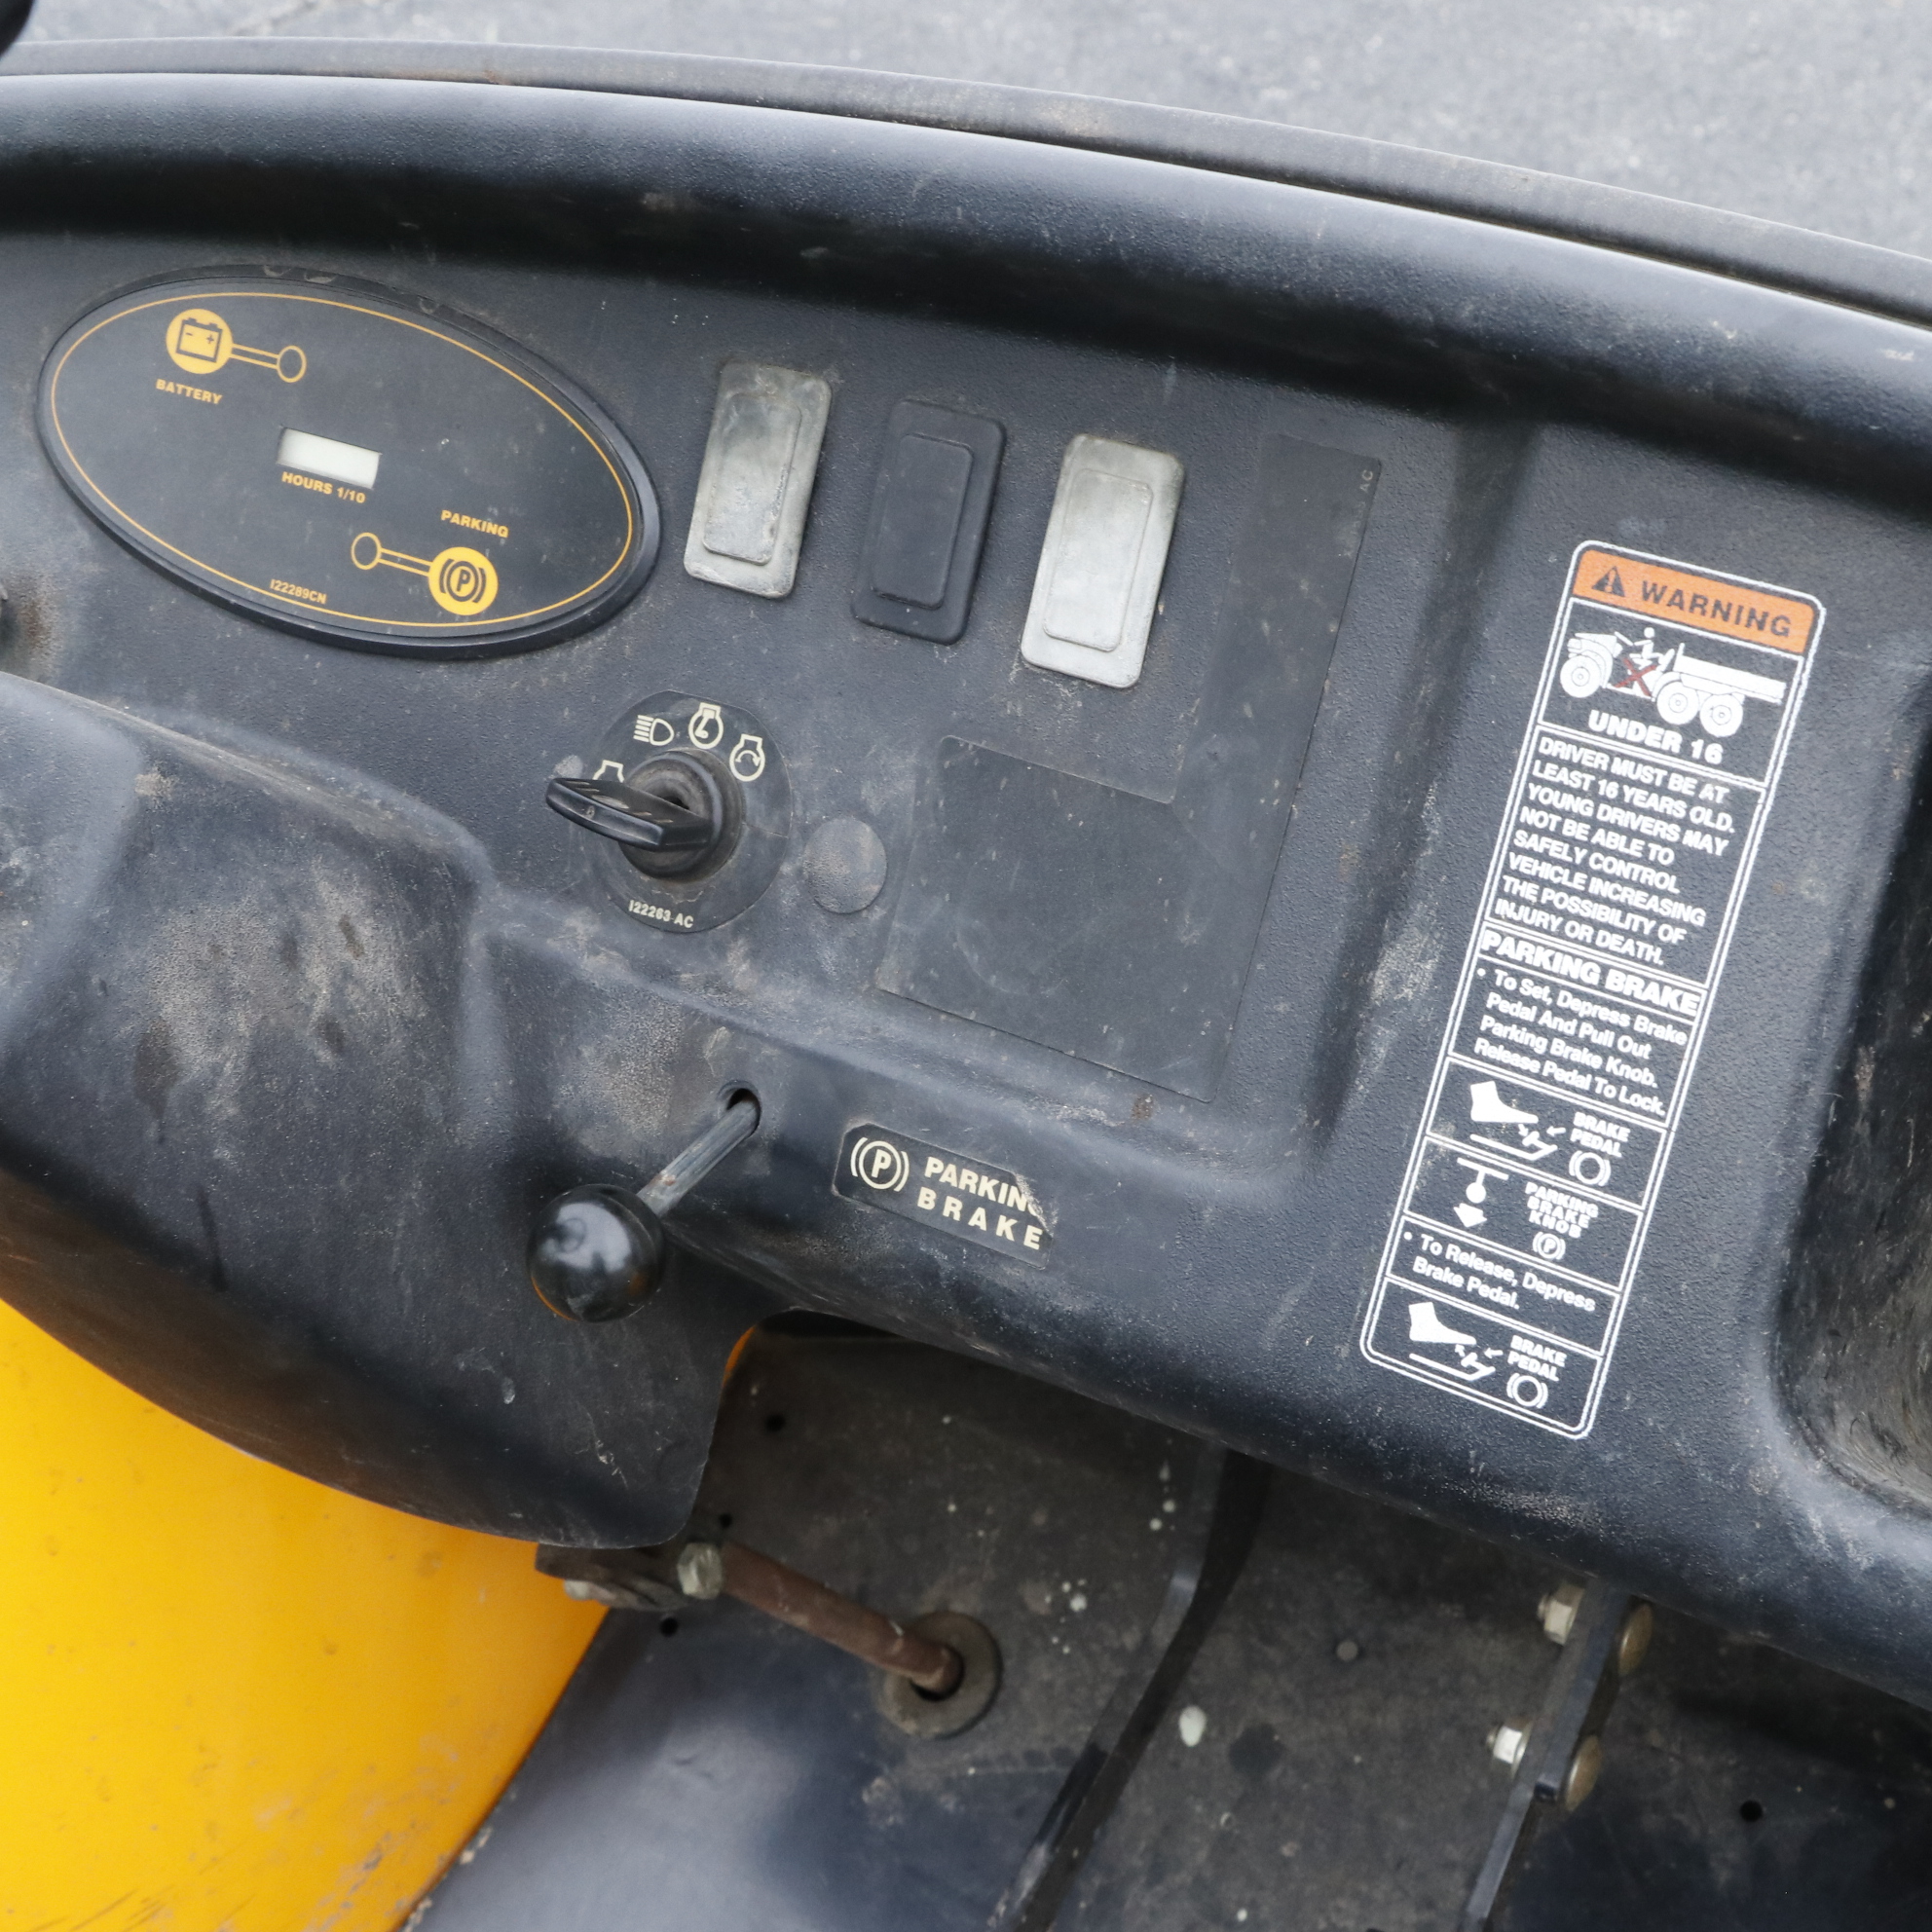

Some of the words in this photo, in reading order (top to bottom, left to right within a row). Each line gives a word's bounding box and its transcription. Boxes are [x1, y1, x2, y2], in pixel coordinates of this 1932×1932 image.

[155, 379, 222, 405] BATTERY
[281, 471, 333, 495] HOURS
[337, 487, 366, 503] 1/10
[440, 509, 509, 539] PARKING
[1642, 580, 1791, 637] WARNING
[1588, 710, 1683, 753] UNDER
[1691, 739, 1724, 764] 16
[1532, 760, 1595, 791] LEAST
[1598, 779, 1619, 799] 16
[1622, 785, 1688, 819] YEARS
[1690, 806, 1735, 833] OLD.
[1539, 737, 1610, 770] DRIVER
[1611, 758, 1667, 786] MUST
[1667, 773, 1697, 797] BE
[1698, 784, 1730, 803] AT
[1520, 806, 1562, 831] NOT
[1562, 819, 1591, 840] BE
[1590, 832, 1645, 858] ABLE
[1648, 842, 1675, 865] TO
[1529, 783, 1594, 817] YOUNG
[1597, 803, 1681, 842] DRIVERS
[1682, 830, 1729, 856] MAY
[1509, 852, 1588, 891] VEHICLE
[1588, 876, 1706, 926] INCREASING
[1513, 830, 1587, 865] SAFELY
[1589, 853, 1680, 894] CONTROL
[1495, 899, 1563, 932] INJURY
[1565, 920, 1594, 944] OR
[1595, 930, 1664, 965] DEATH.
[1503, 875, 1540, 901] THE
[1541, 888, 1656, 936] POSSIBILITY
[1657, 924, 1687, 944] OF
[1481, 929, 1601, 984] PARKING
[1605, 969, 1701, 1017] BRAKE
[1486, 992, 1537, 1022] Pedal
[1538, 1010, 1578, 1035] And
[1579, 1022, 1615, 1047] Pull
[1617, 1035, 1653, 1059] Out
[1495, 969, 1517, 990] To
[1519, 979, 1553, 1005] Set,
[1557, 990, 1631, 1027] Depress
[1634, 1015, 1688, 1045] Brake
[1474, 1037, 1541, 1073] Release
[1542, 1060, 1592, 1091] Pedal
[1594, 1077, 1616, 1098] To
[1618, 1086, 1666, 1116] Lock.
[1480, 1015, 1548, 1055] Parking
[1550, 1038, 1603, 1068] Brake
[1606, 1056, 1658, 1088] Knob.
[1570, 1129, 1622, 1157] PEDAL
[1574, 1112, 1630, 1142] BRAKE
[917, 1187, 1042, 1249] BRAKE
[1525, 1181, 1599, 1218] PARKING
[1527, 1196, 1590, 1228] BRAKE
[1529, 1209, 1581, 1239] KNOB
[1412, 1256, 1465, 1287] Brake
[1467, 1276, 1519, 1309] Pedal.
[1421, 1234, 1443, 1255] To
[1445, 1244, 1518, 1286] Release,
[1522, 1272, 1596, 1311] Depress
[1507, 1351, 1560, 1382] PEDAL
[1510, 1335, 1567, 1366] BRAKE
